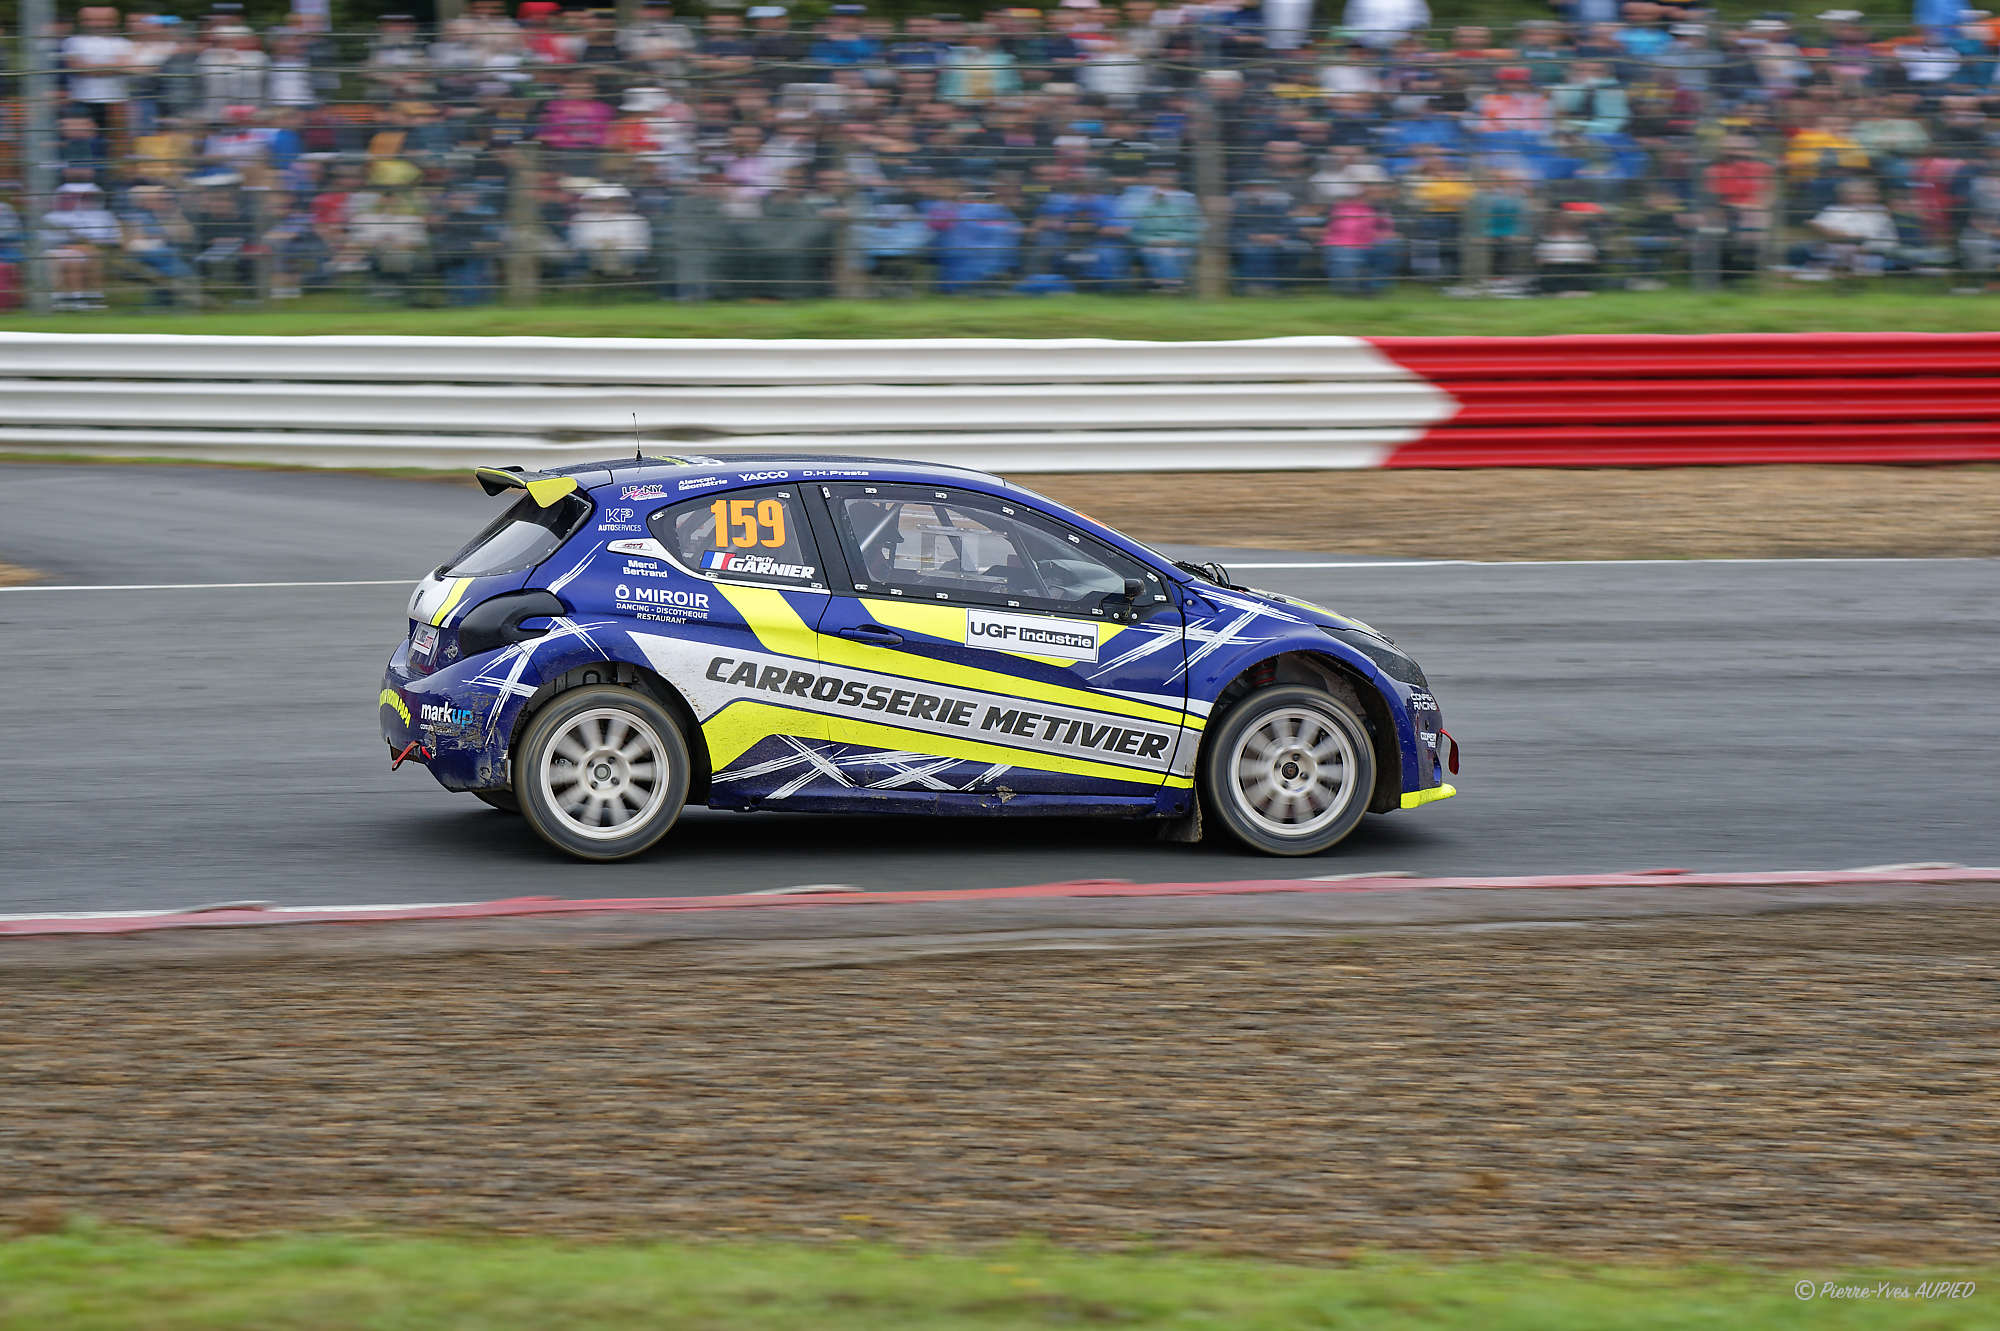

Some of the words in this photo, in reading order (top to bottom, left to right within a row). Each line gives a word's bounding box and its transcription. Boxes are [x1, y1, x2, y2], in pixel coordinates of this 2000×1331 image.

[738, 470, 789, 482] YACCO
[605, 508, 634, 523] KP
[710, 499, 786, 548] 159
[623, 566, 668, 578] Bertrand
[628, 559, 658, 570] Merci
[727, 557, 816, 579] GARNIER
[635, 587, 709, 609] MIROIR
[616, 602, 649, 612] DANCING
[656, 606, 708, 619] DISCOTHEQUE
[637, 612, 687, 625] RESTAURANT
[970, 621, 1017, 639] UGF
[1021, 628, 1093, 648] industrie
[421, 701, 473, 728] markup
[705, 656, 978, 727] CARROSSERIE
[980, 705, 1171, 760] METIVIER
